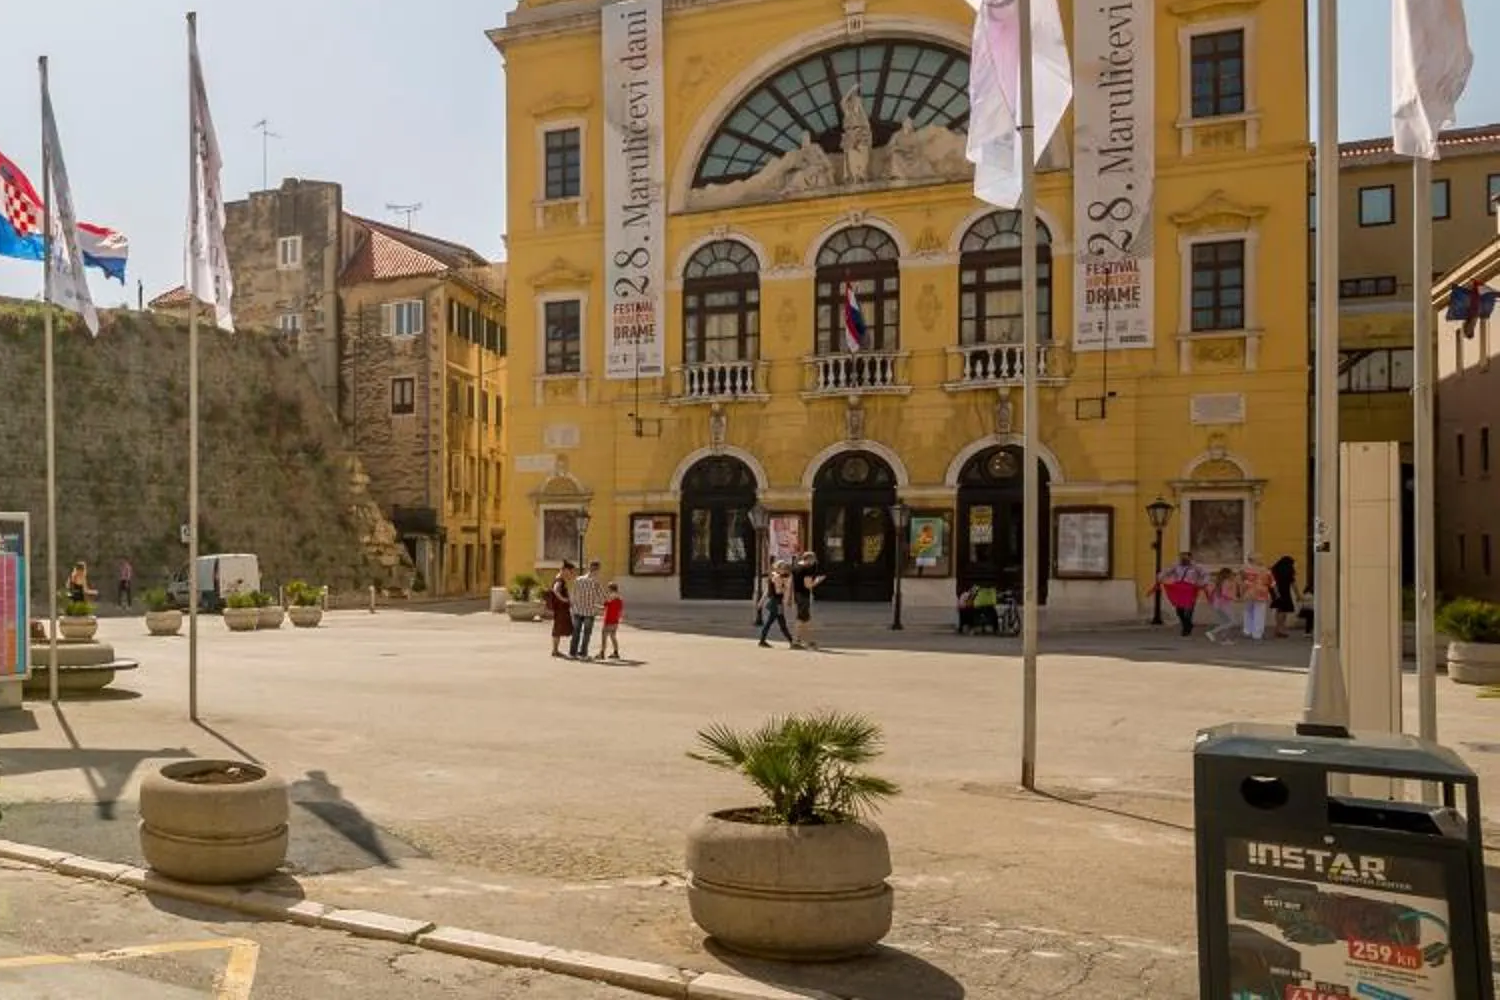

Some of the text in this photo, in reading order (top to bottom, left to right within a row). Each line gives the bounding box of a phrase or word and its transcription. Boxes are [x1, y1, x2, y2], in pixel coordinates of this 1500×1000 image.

[1098, 0, 1134, 176] Marulićevi
[613, 9, 651, 297] 28. Marulićevi dani
[1088, 183, 1134, 254] 28.
[1086, 259, 1140, 276] FESTIVAL
[1086, 286, 1141, 304] DRAME
[613, 324, 656, 340] DRAME
[1247, 841, 1387, 881] INSTAR
[1352, 941, 1418, 968] 259 kn
